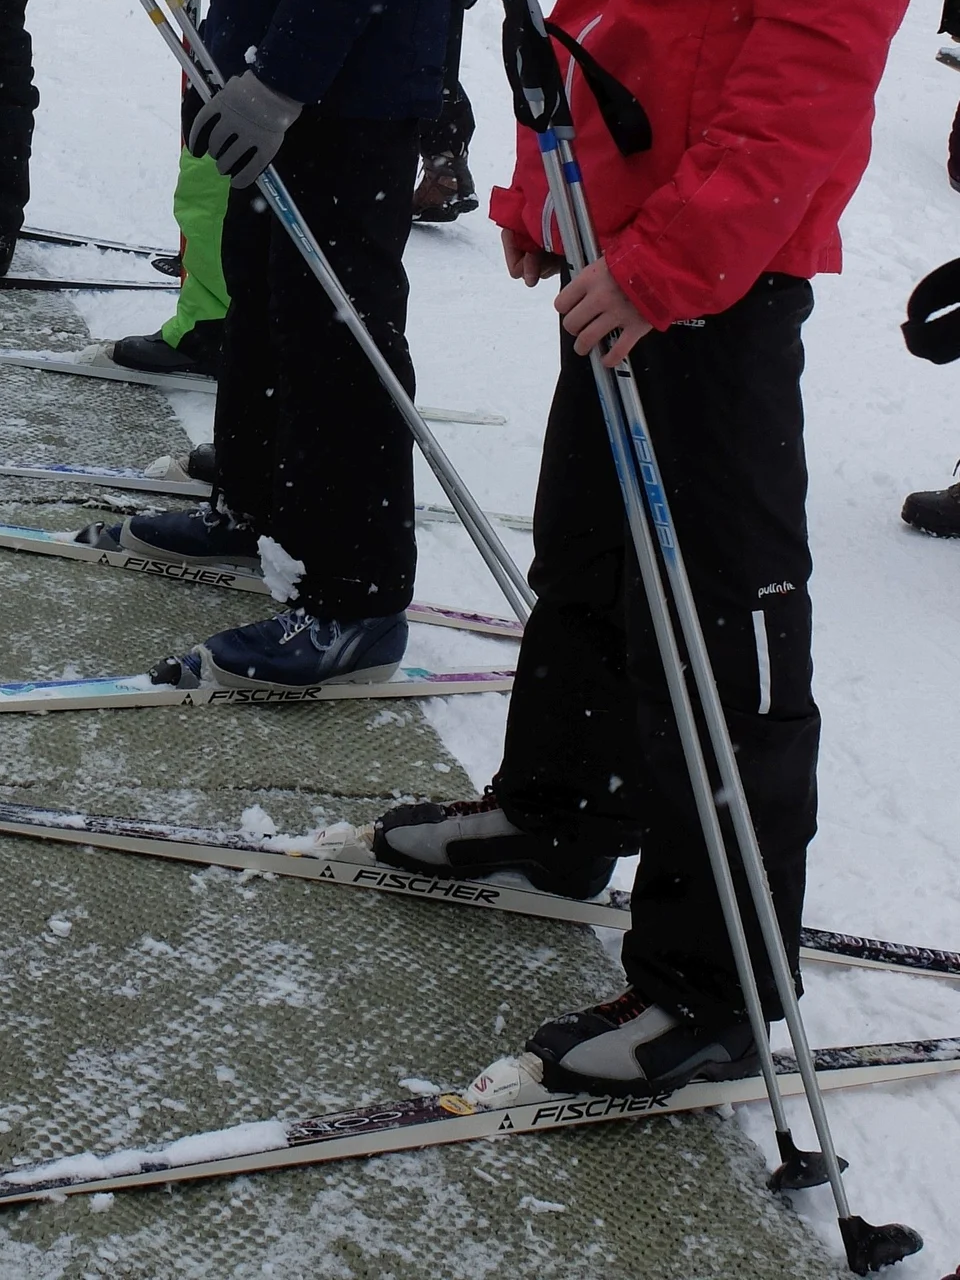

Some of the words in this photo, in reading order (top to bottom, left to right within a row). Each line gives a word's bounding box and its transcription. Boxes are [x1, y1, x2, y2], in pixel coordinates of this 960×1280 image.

[124, 557, 236, 587] FISCHER
[208, 686, 322, 704] FISCHER
[353, 869, 500, 905] FISCHER
[531, 1093, 672, 1126] FISCHER
